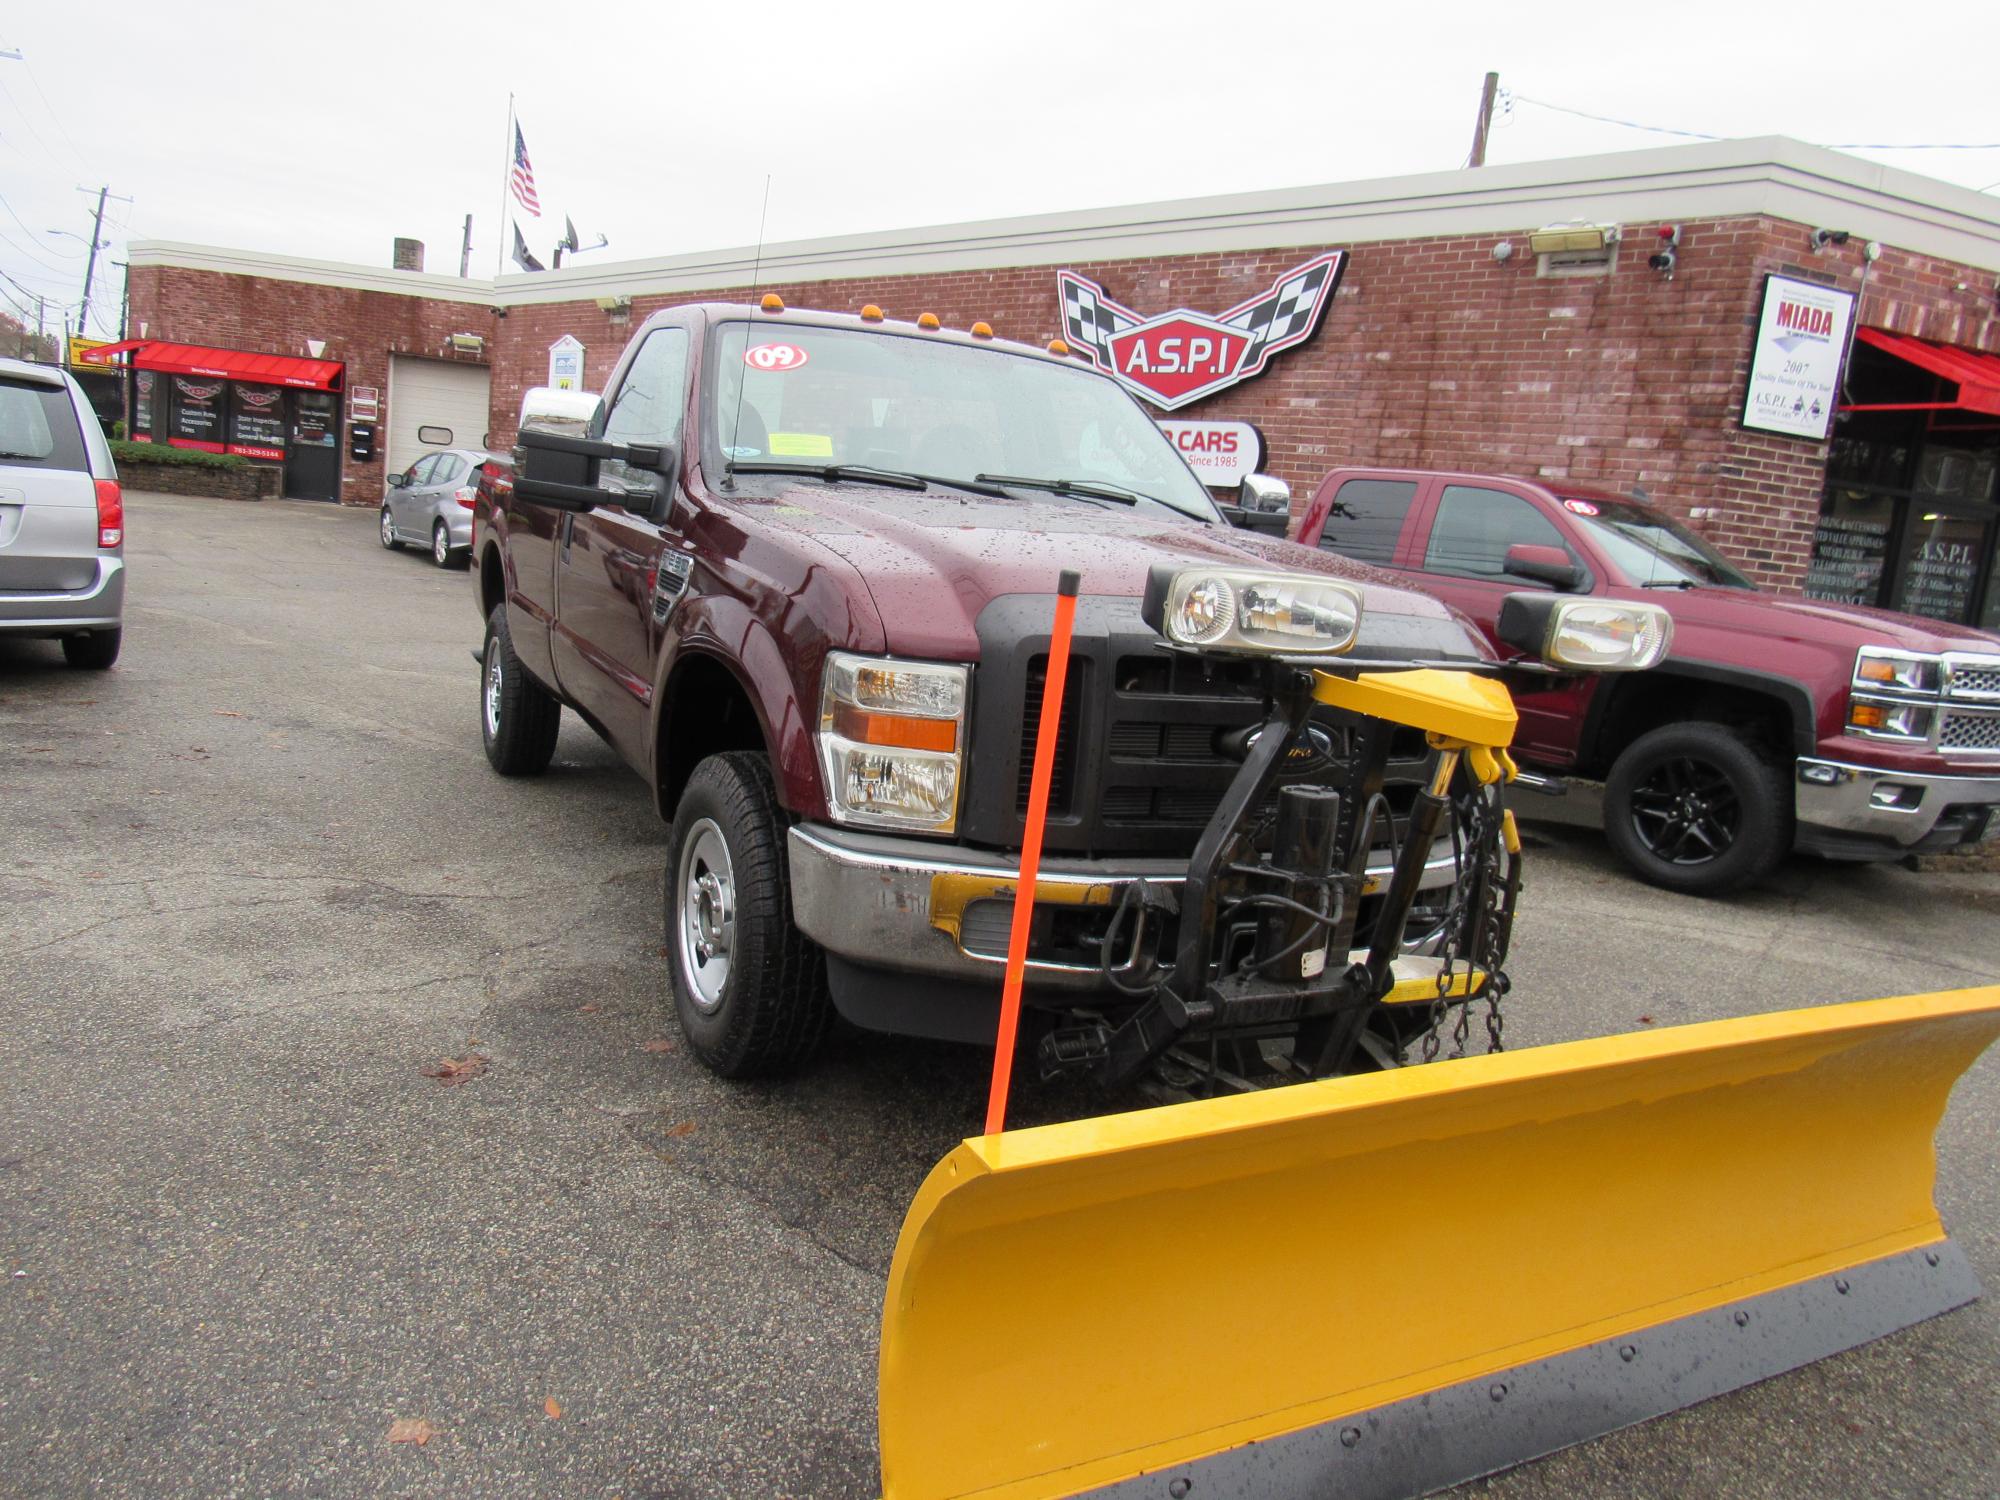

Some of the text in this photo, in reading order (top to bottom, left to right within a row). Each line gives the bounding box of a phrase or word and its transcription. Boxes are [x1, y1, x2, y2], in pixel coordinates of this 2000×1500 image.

[1776, 301, 1833, 336] MIADA
[1125, 338, 1229, 374] A.S.P.I
[1784, 360, 1810, 374] 2007
[181, 409, 202, 417] Custom
[181, 418, 213, 427] Accessories
[253, 417, 281, 426] Inspection
[181, 426, 196, 434] Tires
[237, 432, 258, 441] General
[1178, 431, 1239, 453] CARS
[1188, 454, 1238, 468] Since 1985
[1917, 541, 1972, 565] A.S.P.I.
[1821, 592, 1865, 606] FINANCE
